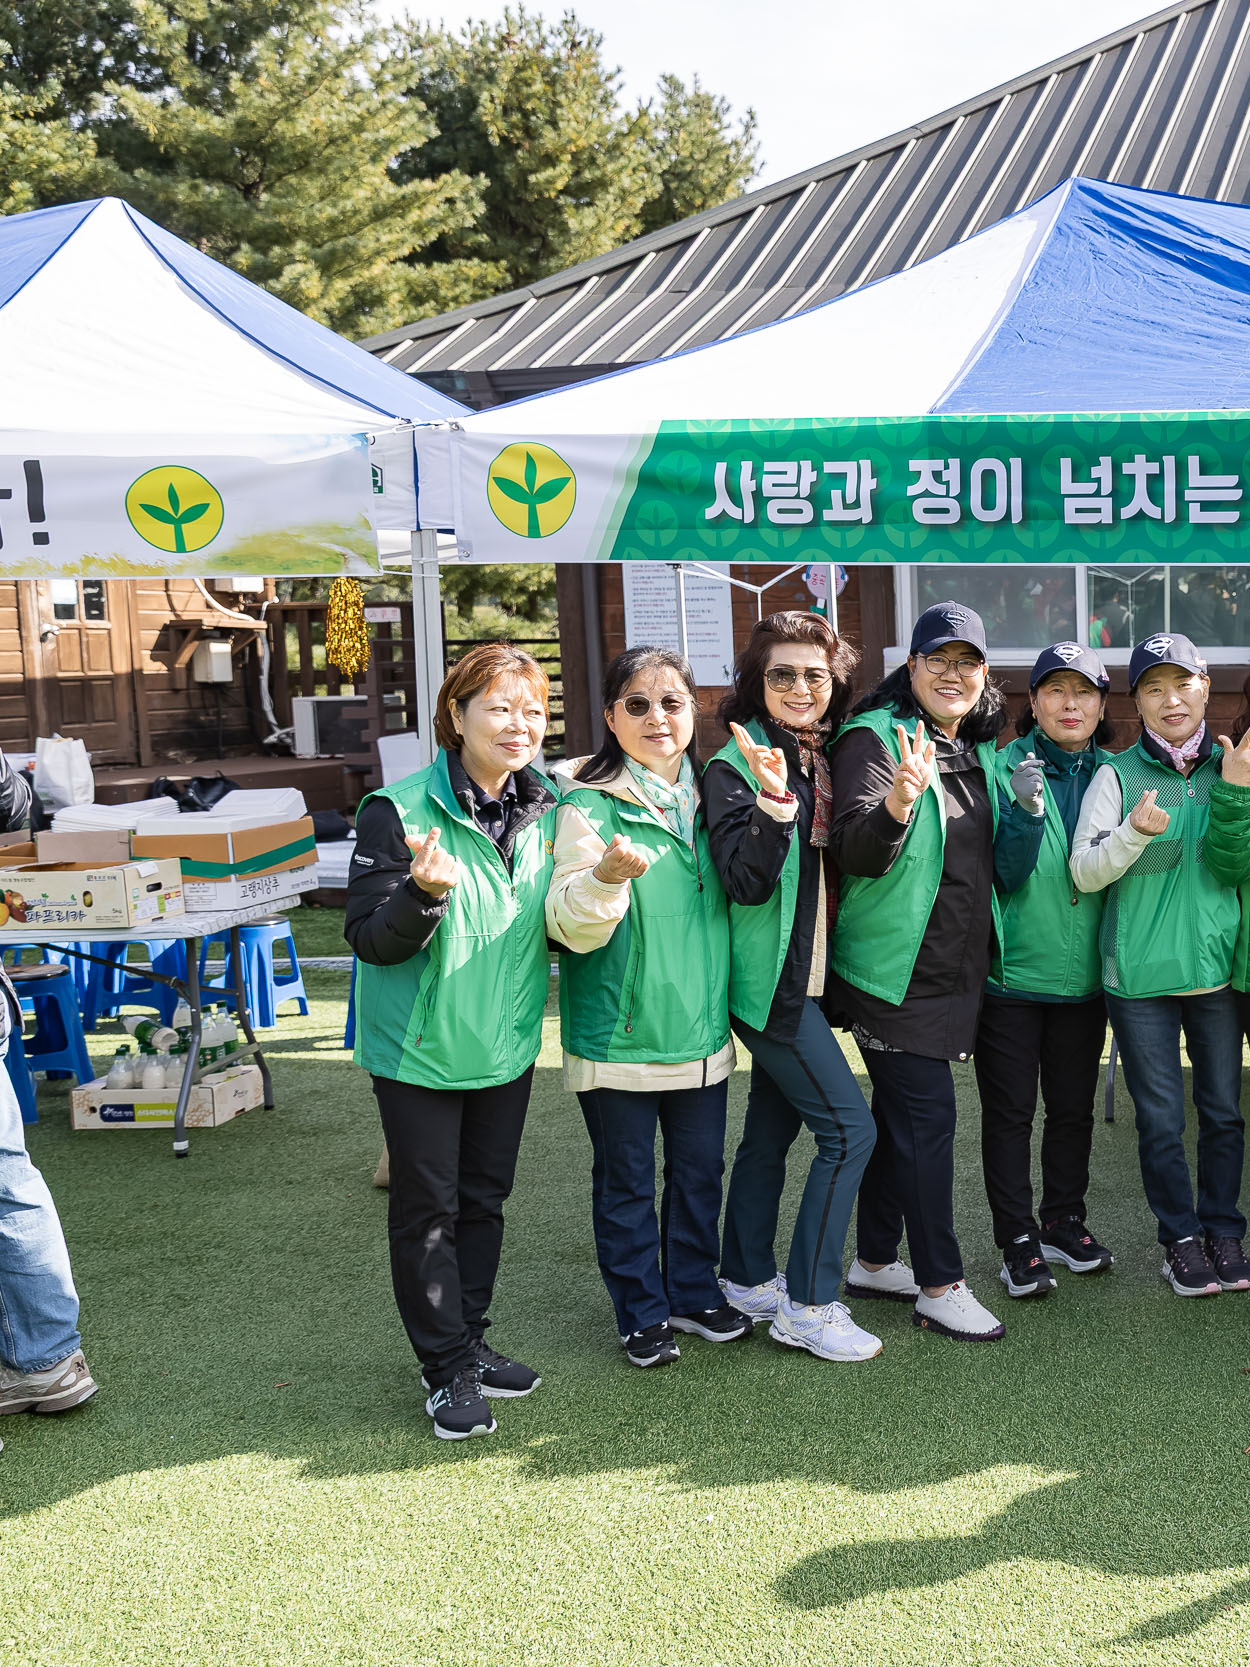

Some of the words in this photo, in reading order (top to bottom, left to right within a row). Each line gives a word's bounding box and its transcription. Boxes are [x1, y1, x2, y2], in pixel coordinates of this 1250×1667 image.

[705, 459, 878, 525] 사랑과
[906, 457, 1024, 526] 정이
[1060, 454, 1244, 525] 넘치는
[240, 876, 280, 899] 고랭지상추
[26, 909, 87, 924] 파프리카
